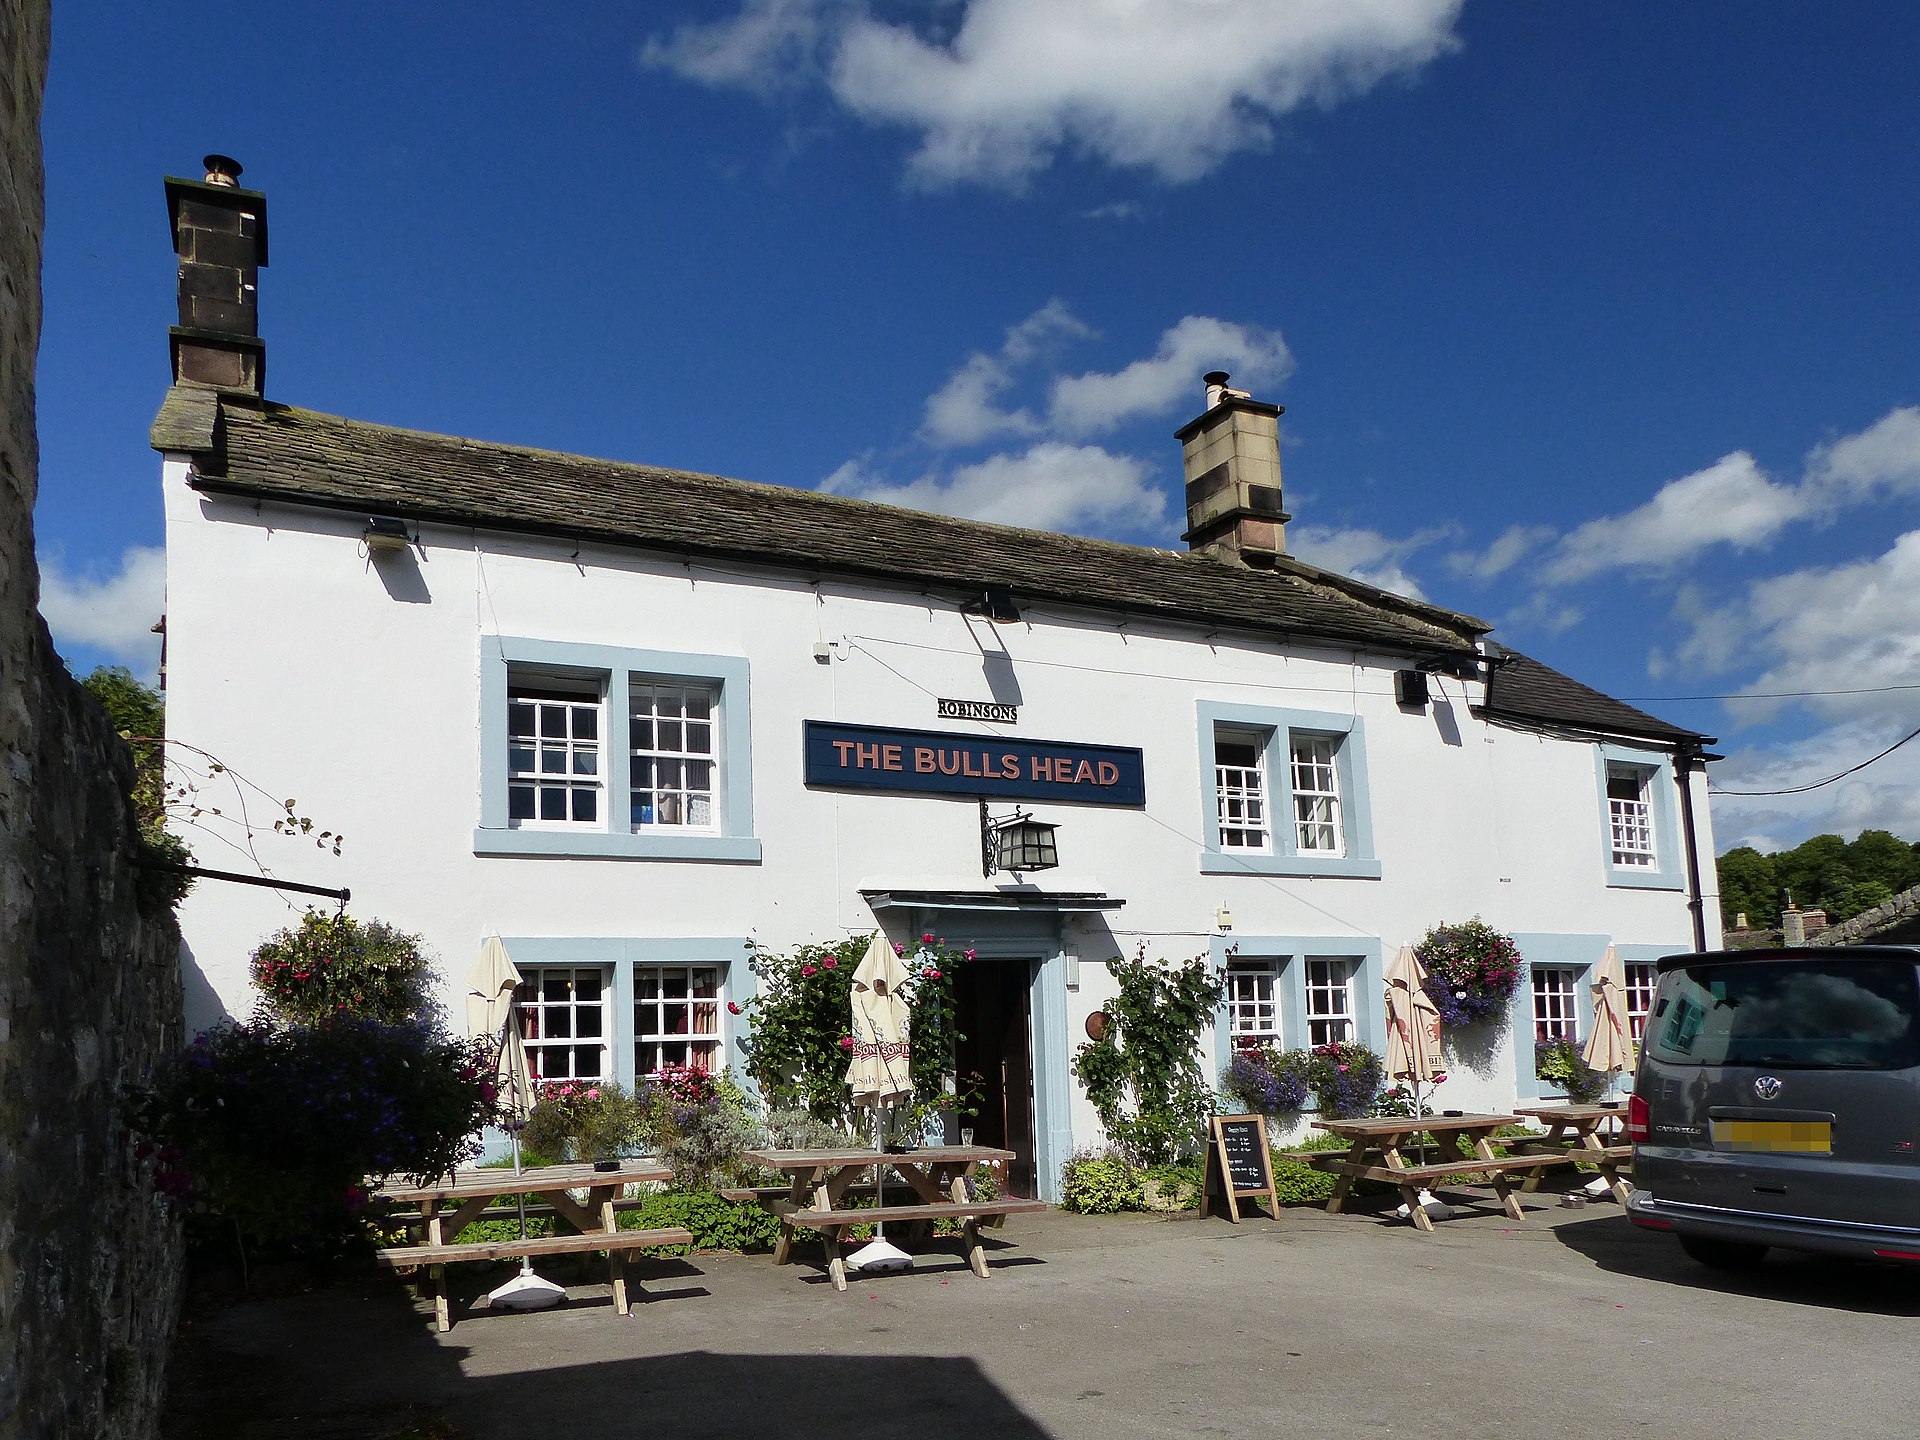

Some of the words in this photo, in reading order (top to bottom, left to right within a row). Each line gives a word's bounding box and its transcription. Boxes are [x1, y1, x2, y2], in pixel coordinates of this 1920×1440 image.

[937, 701, 1018, 721] ROBINSONS
[832, 740, 903, 771] THE
[914, 747, 1021, 780] BULLS
[1031, 756, 1120, 785] HEAD
